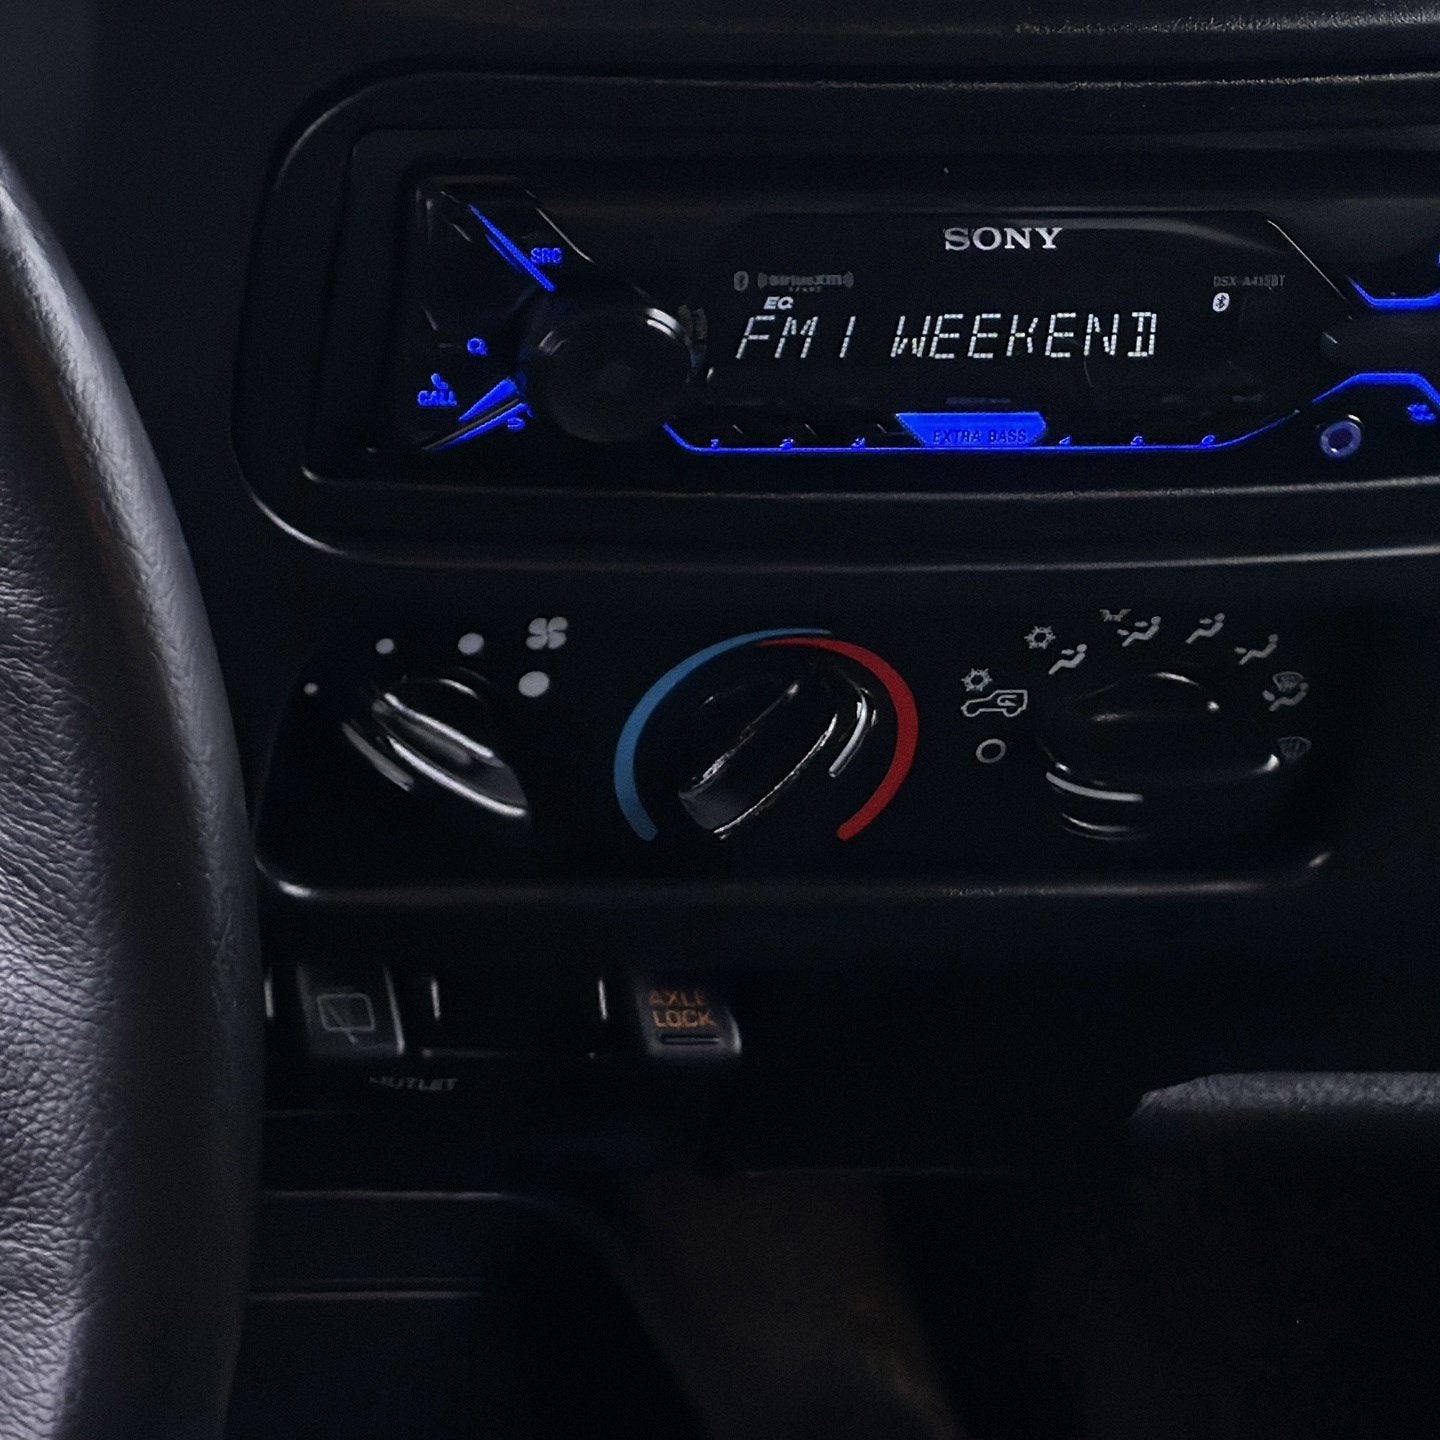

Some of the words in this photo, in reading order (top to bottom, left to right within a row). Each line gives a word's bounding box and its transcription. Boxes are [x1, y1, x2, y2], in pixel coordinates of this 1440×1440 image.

[943, 226, 1063, 252] SONY
[530, 247, 562, 264] SRC
[763, 295, 795, 311] EQ
[890, 311, 1160, 360] WEEKEND
[417, 389, 458, 406] CALL
[931, 428, 982, 446] EXTRA
[987, 428, 1029, 445] BASS
[651, 1008, 717, 1028] LOCK
